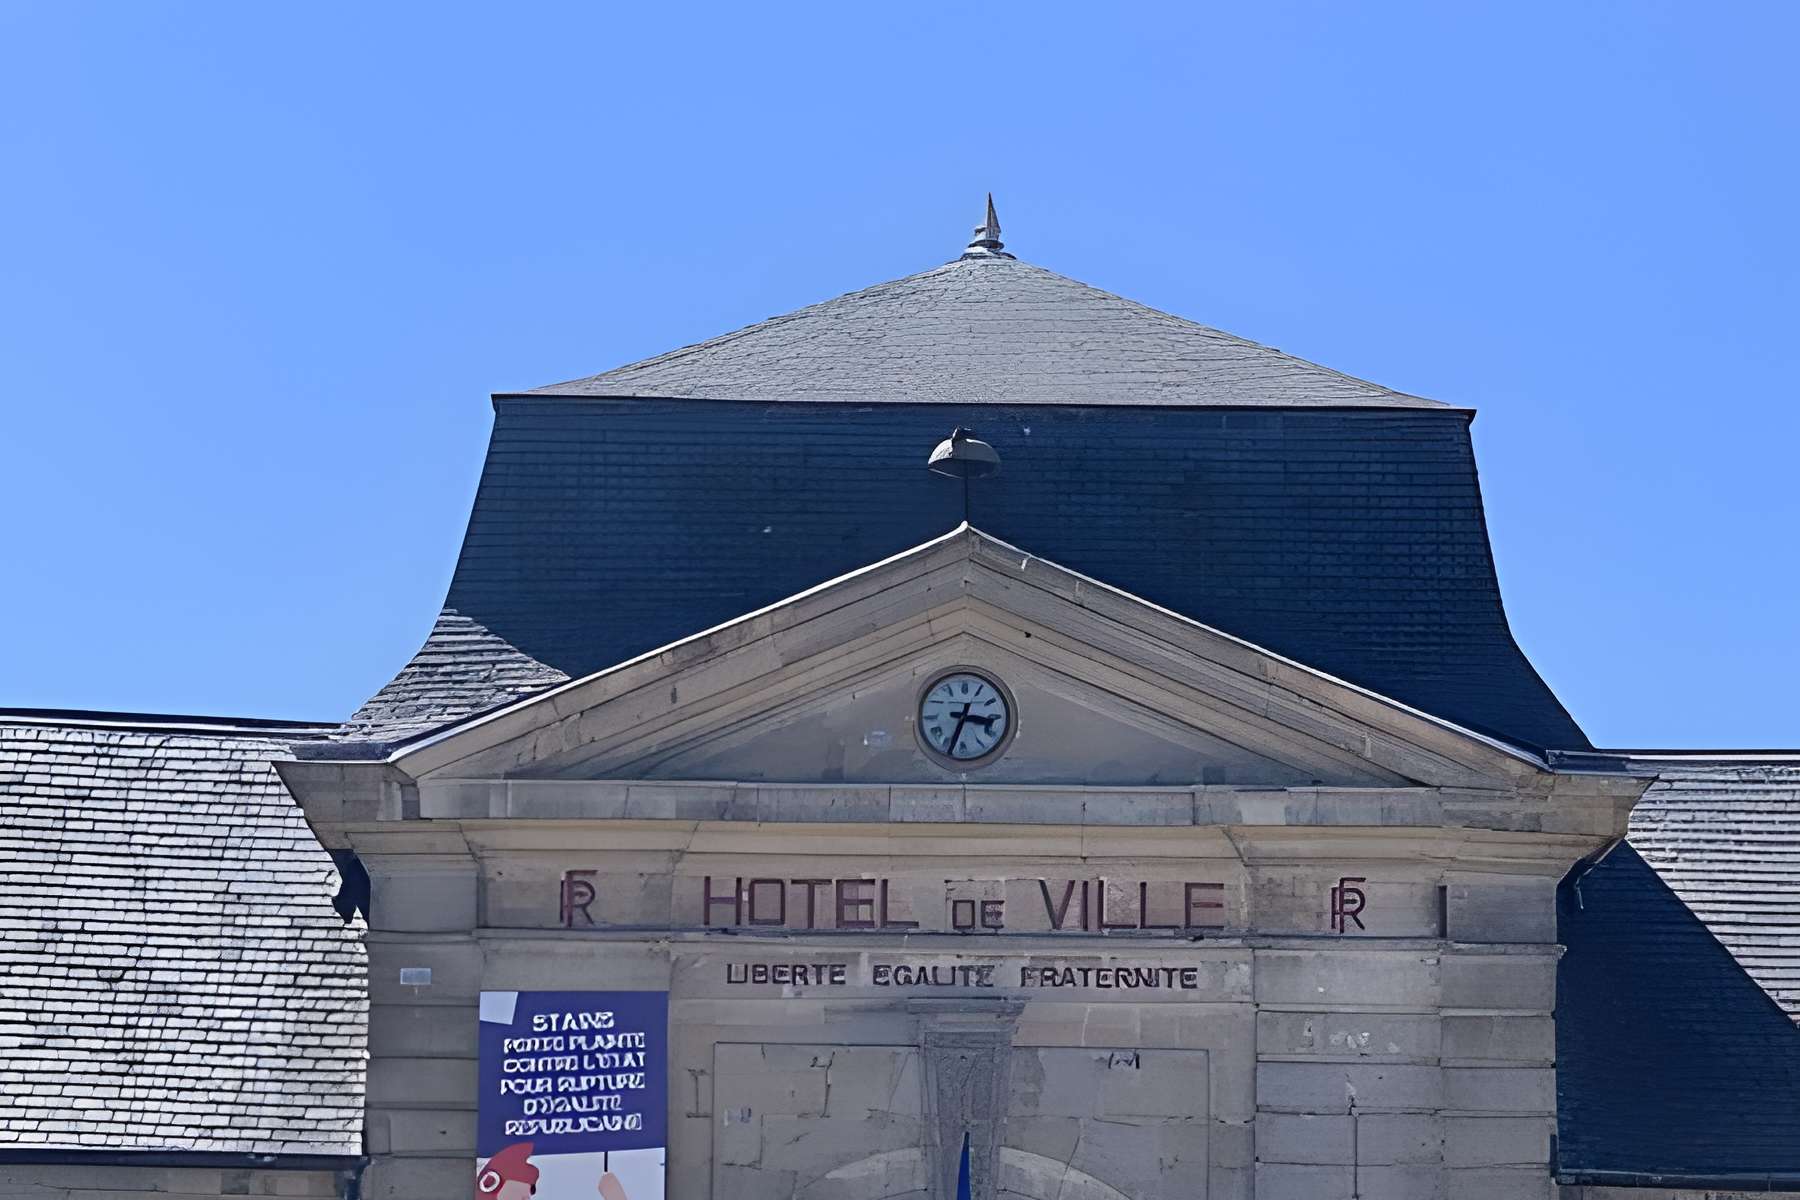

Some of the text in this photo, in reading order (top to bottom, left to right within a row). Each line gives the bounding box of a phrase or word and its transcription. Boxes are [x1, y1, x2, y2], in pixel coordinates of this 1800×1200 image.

[703, 875, 1225, 931] HOTEL DE VILLE
